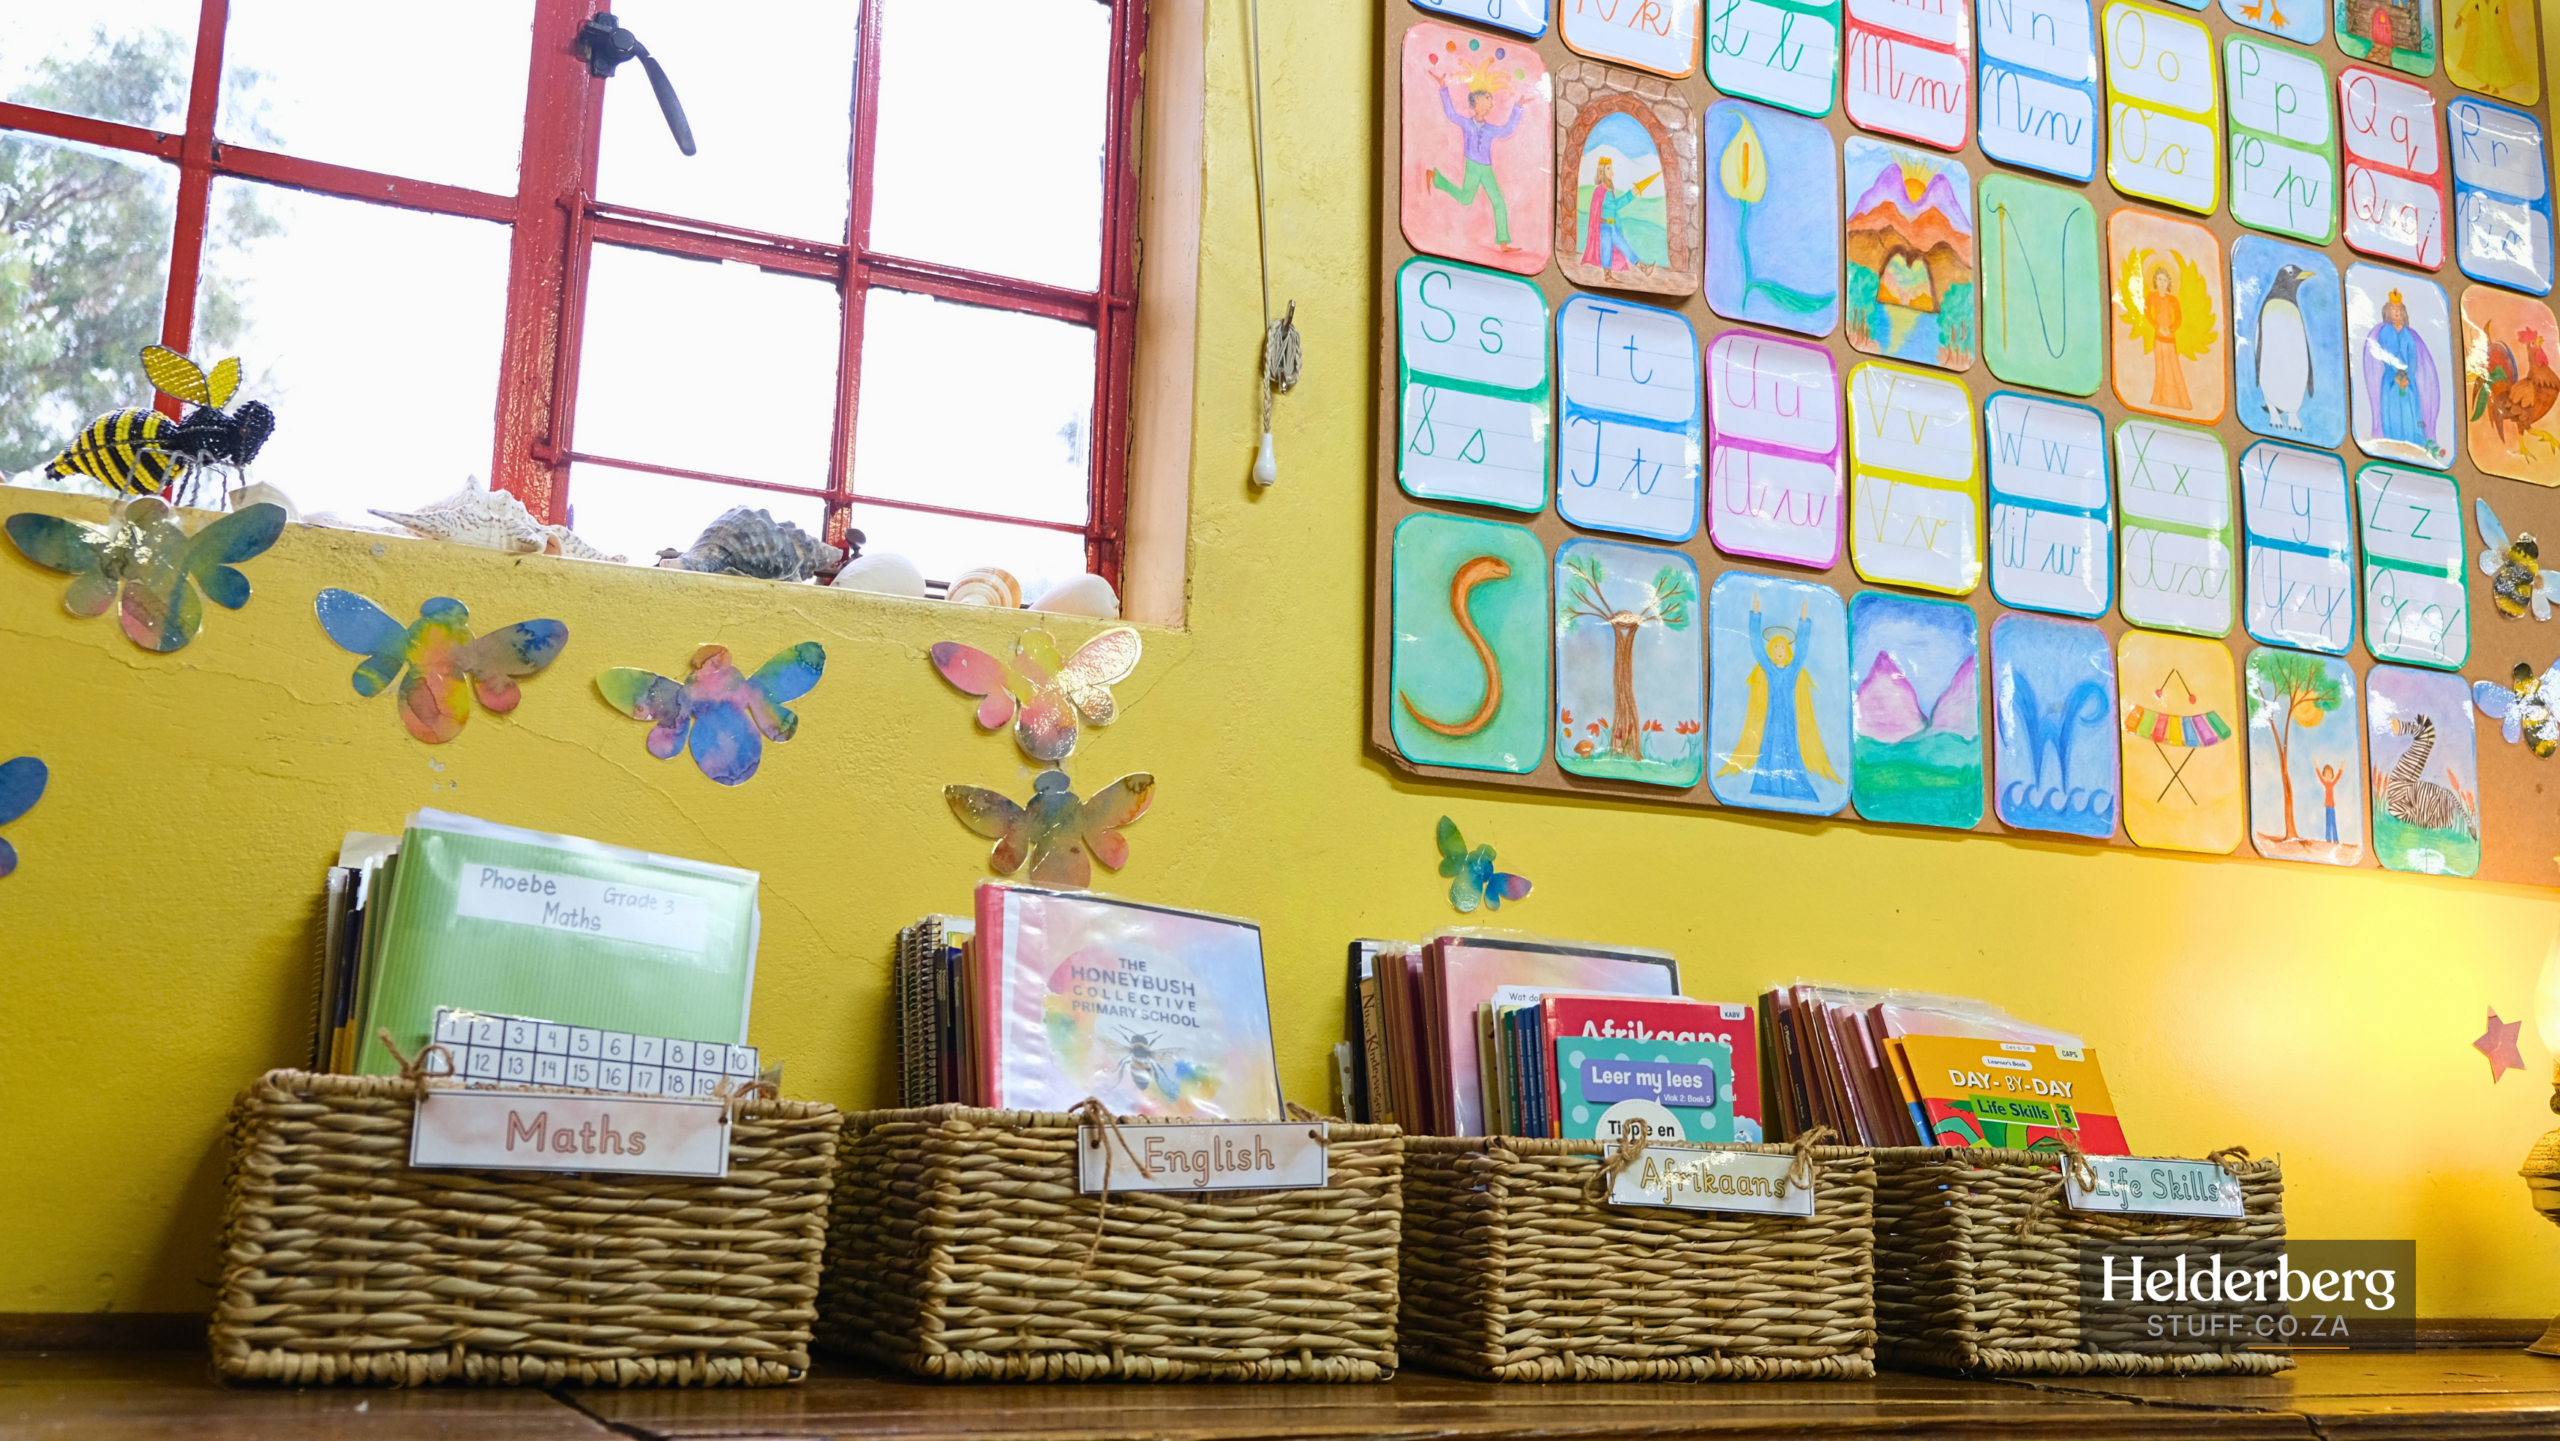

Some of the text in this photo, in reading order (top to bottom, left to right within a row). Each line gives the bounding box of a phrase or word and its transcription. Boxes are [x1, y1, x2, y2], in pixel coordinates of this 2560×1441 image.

[480, 867, 676, 915] Phoebe Grade 3
[542, 902, 602, 932] Maths
[1118, 958, 1147, 972] THE
[1071, 966, 1195, 997] HONEYBUSH
[1073, 985, 1197, 1012] COLLECTIVE
[1509, 992, 1526, 1001] Wat
[1072, 1000, 1200, 1028] PRIMARY SCHOOL
[1724, 1011, 1740, 1019] KABV
[480, 1024, 492, 1042] 2
[512, 1027, 524, 1045] 3
[548, 1031, 557, 1049] 4
[577, 1034, 589, 1053] 5
[610, 1038, 621, 1056] 6
[643, 1042, 653, 1060] 7
[672, 1046, 684, 1064] 8
[703, 1049, 715, 1066] 9
[731, 1052, 748, 1071] 10
[2062, 1050, 2078, 1059] CAPS
[475, 1053, 490, 1073] 12
[507, 1056, 524, 1075] 13
[541, 1060, 557, 1079] 14
[573, 1063, 589, 1083] 15
[605, 1067, 622, 1086] 16
[638, 1071, 653, 1089] 17
[668, 1075, 684, 1094] 18
[699, 1078, 715, 1096] 19
[1987, 1058, 2012, 1067] Learner's
[1592, 1066, 1703, 1094] Leer my lees
[1663, 1094, 1679, 1102] Vlak
[1680, 1094, 1687, 1103] 2:
[1688, 1095, 1706, 1104] Boek
[1976, 1099, 2050, 1120] Life Skills
[2061, 1109, 2072, 1123] 3
[506, 1110, 647, 1157] Maths
[1658, 1125, 1675, 1137] en
[1144, 1135, 1276, 1188] English
[1641, 1156, 1786, 1204] Afrikaans
[2093, 1165, 2220, 1210] Life Skills
